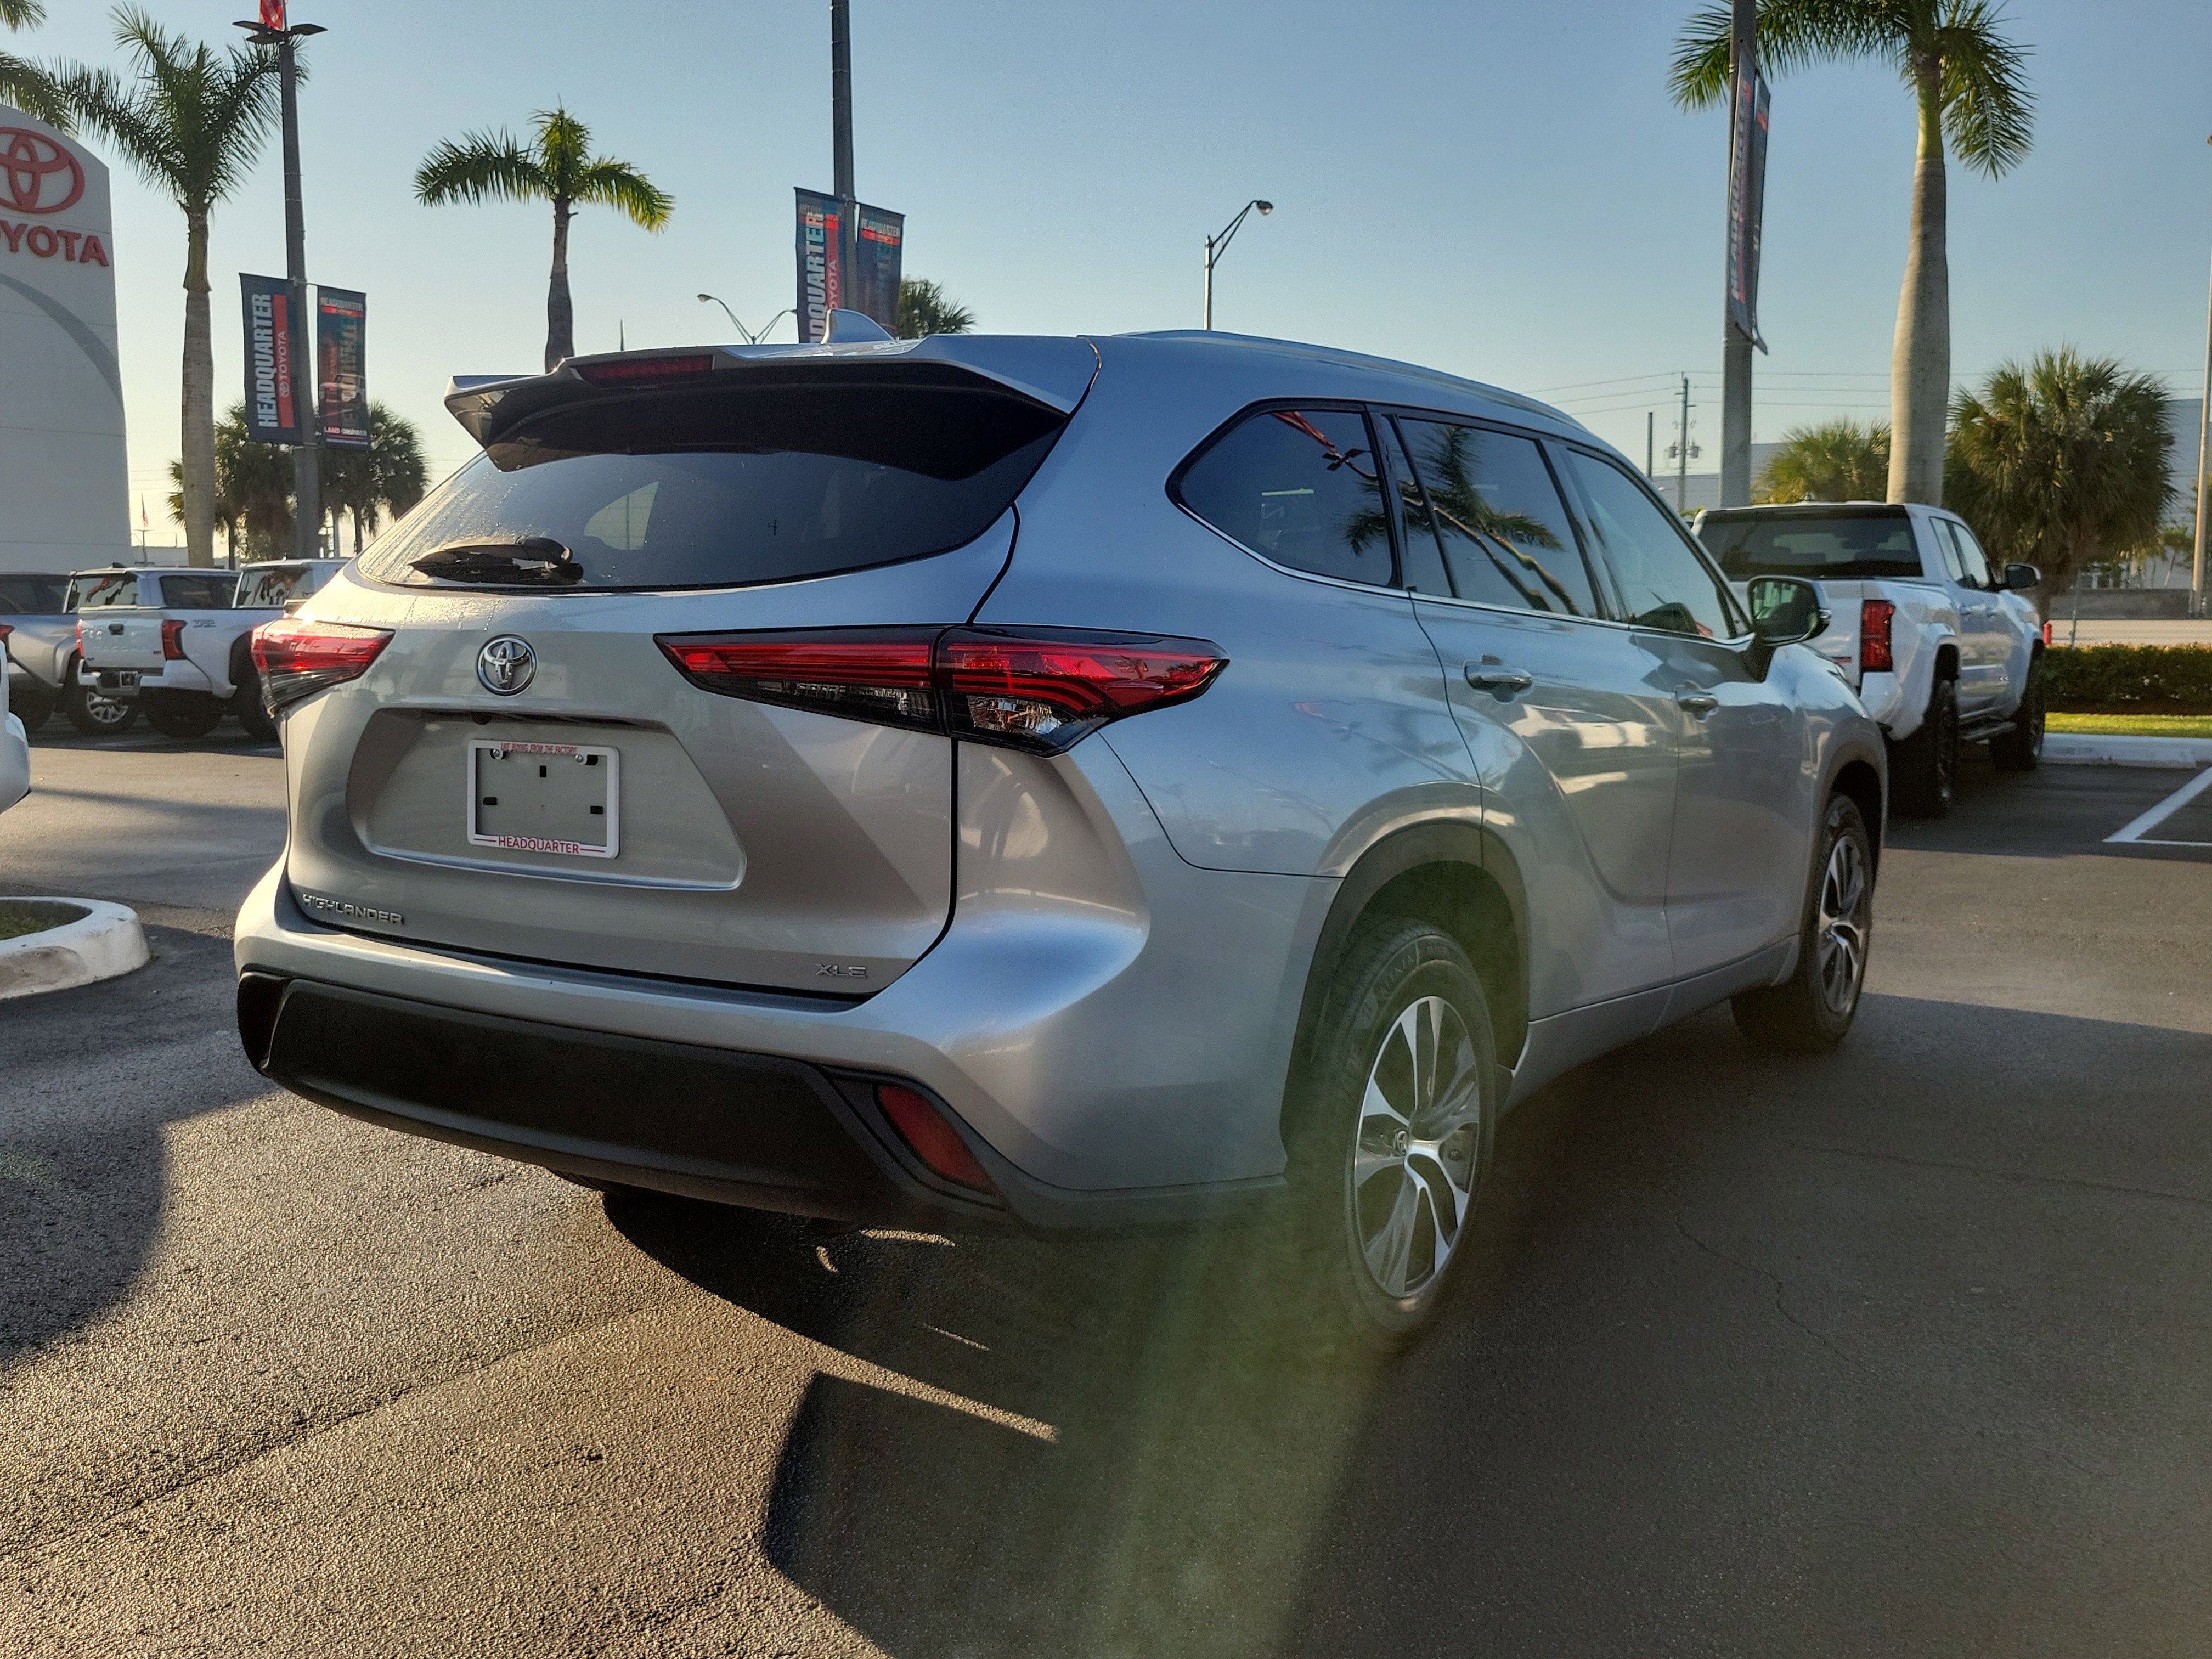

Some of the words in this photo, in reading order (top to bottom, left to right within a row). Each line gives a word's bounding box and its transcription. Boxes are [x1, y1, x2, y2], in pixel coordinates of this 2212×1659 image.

[251, 293, 279, 428] HEADQUARTER
[277, 331, 289, 380] TOYOTA
[498, 837, 579, 854] HEADQUARTER
[303, 893, 405, 926] HIGHLANDER
[816, 963, 868, 979] XLE
